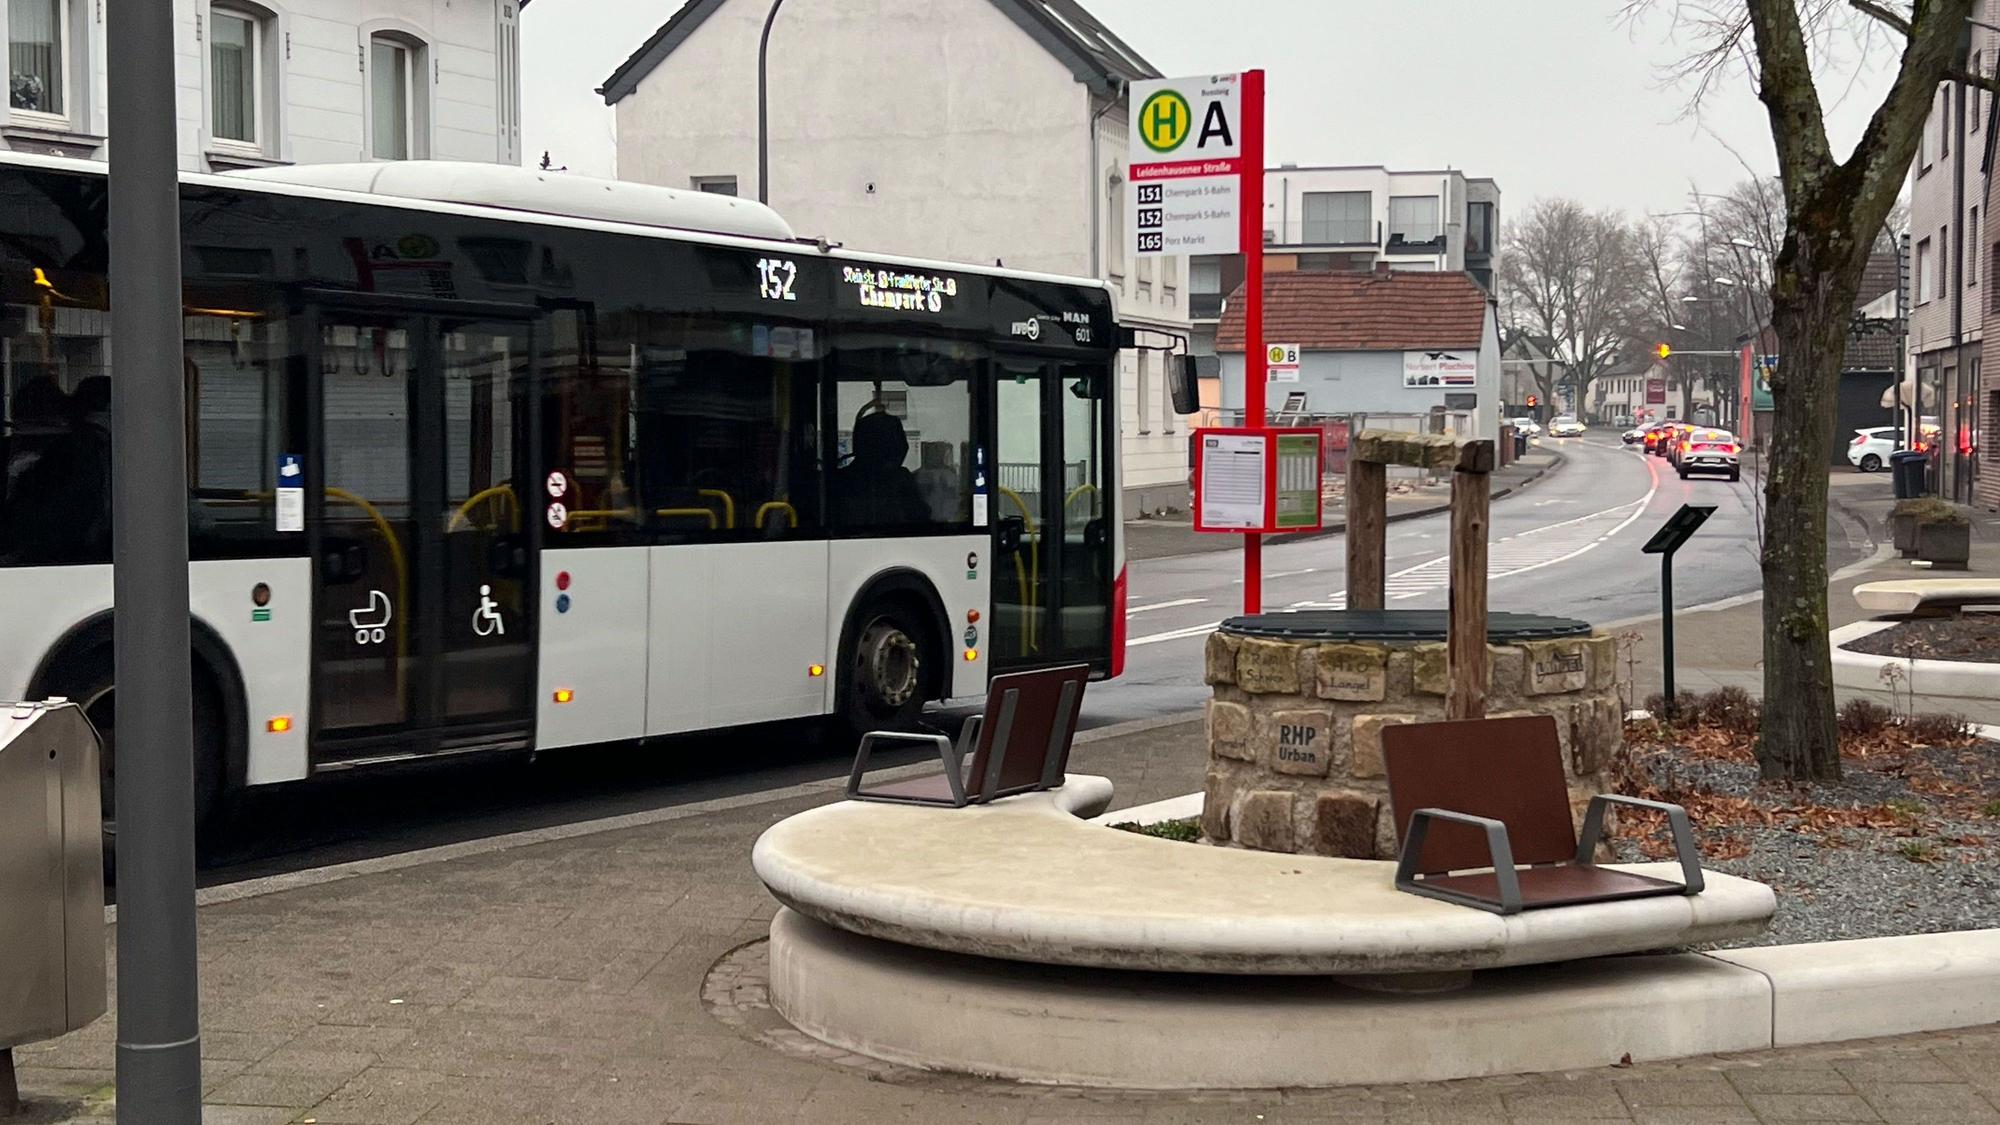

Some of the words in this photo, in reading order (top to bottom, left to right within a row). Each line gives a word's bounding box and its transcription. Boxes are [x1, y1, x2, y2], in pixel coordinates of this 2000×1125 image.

[1153, 101, 1177, 141] H
[1196, 100, 1233, 149] A
[1136, 164, 1202, 178] Leidenhausener
[1203, 161, 1232, 174] Straße
[1139, 187, 1161, 202] 151
[1165, 187, 1203, 198] Chempark
[1204, 185, 1231, 196] S-Bahn
[1139, 211, 1162, 226] 152
[1165, 211, 1203, 222] Chempark
[1204, 209, 1231, 220] S-Bahn
[1139, 235, 1162, 249] 165
[1165, 236, 1181, 246] Porz
[1182, 235, 1205, 245] Markt
[756, 258, 797, 300] 152
[860, 284, 926, 311] Chempark
[1063, 312, 1090, 324] MAN
[1075, 328, 1091, 343] 601
[1287, 350, 1297, 362] B
[1280, 724, 1316, 746] RHP
[1278, 746, 1316, 764] Urban
